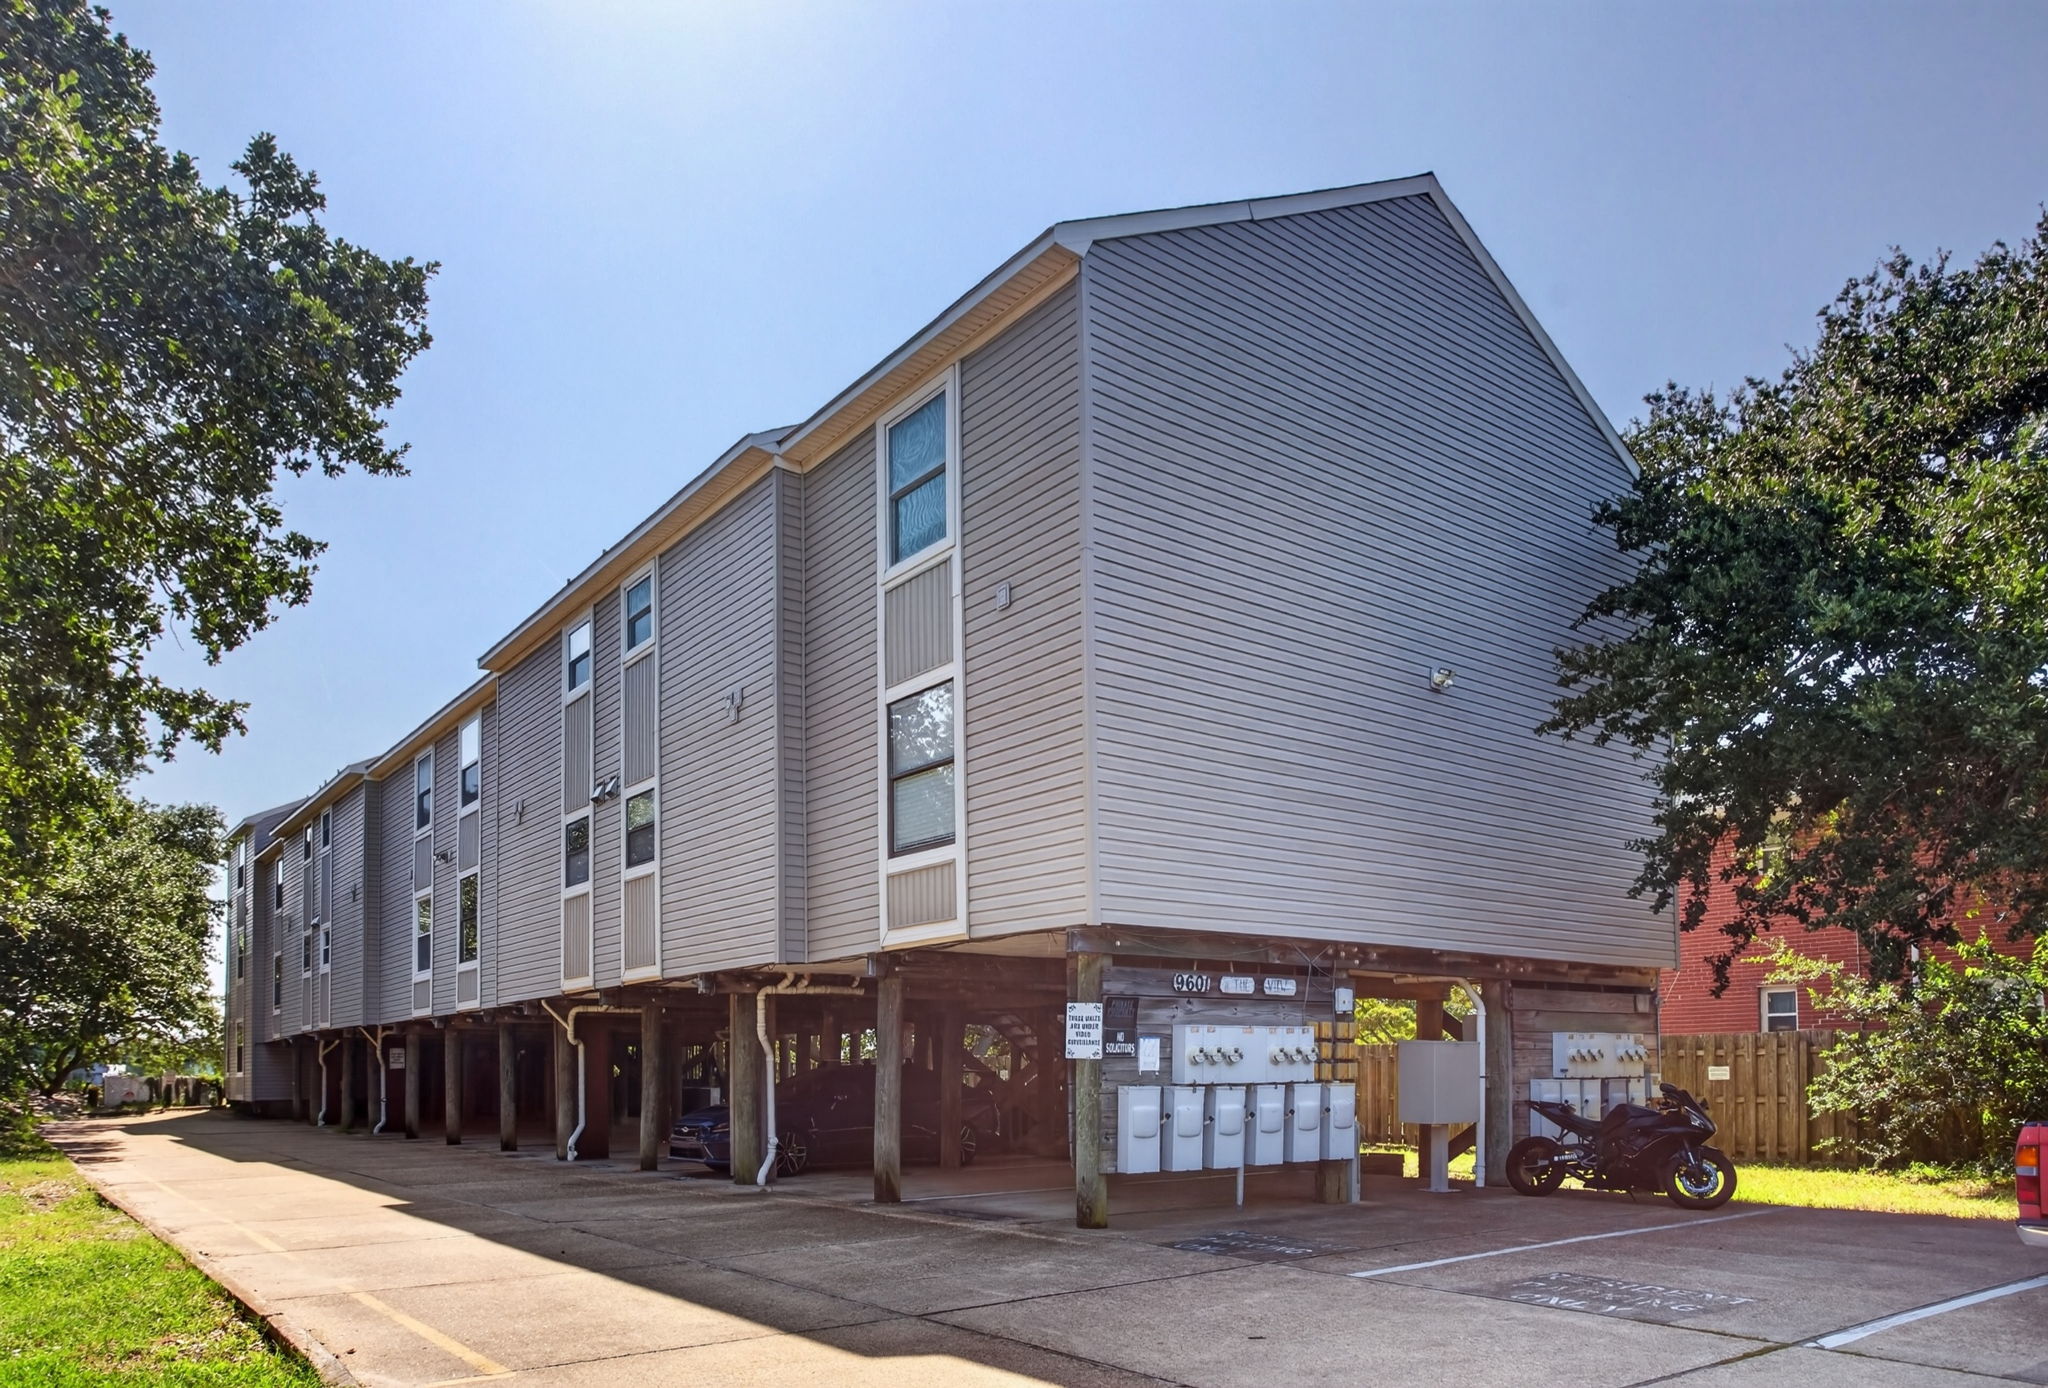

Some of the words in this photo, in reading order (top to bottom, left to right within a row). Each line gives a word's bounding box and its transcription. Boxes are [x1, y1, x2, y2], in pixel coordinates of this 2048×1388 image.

[1174, 974, 1210, 992] 9601
[1116, 1032, 1125, 1042] NO
[1105, 1042, 1136, 1054] SOLICITORS
